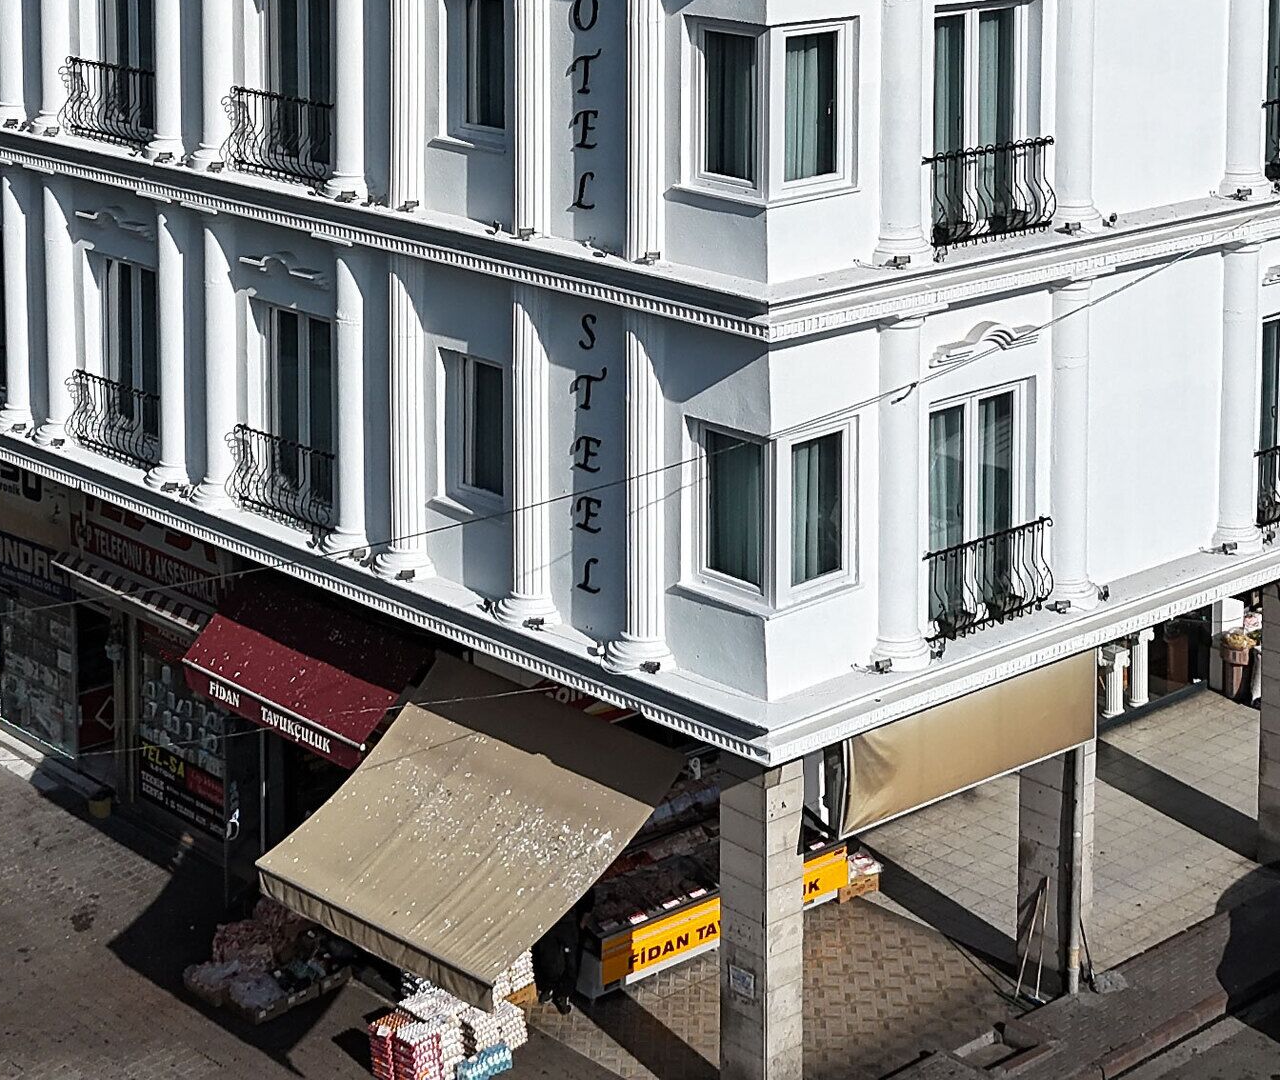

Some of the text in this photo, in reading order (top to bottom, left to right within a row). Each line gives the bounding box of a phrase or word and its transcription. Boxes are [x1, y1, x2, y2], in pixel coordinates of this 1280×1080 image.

[570, 313, 607, 595] STEEL
[94, 529, 142, 569] TELEFONU
[208, 681, 240, 708] FİDAN
[260, 706, 331, 754] TAVUKÇULUK
[628, 932, 689, 970] FİDAN
